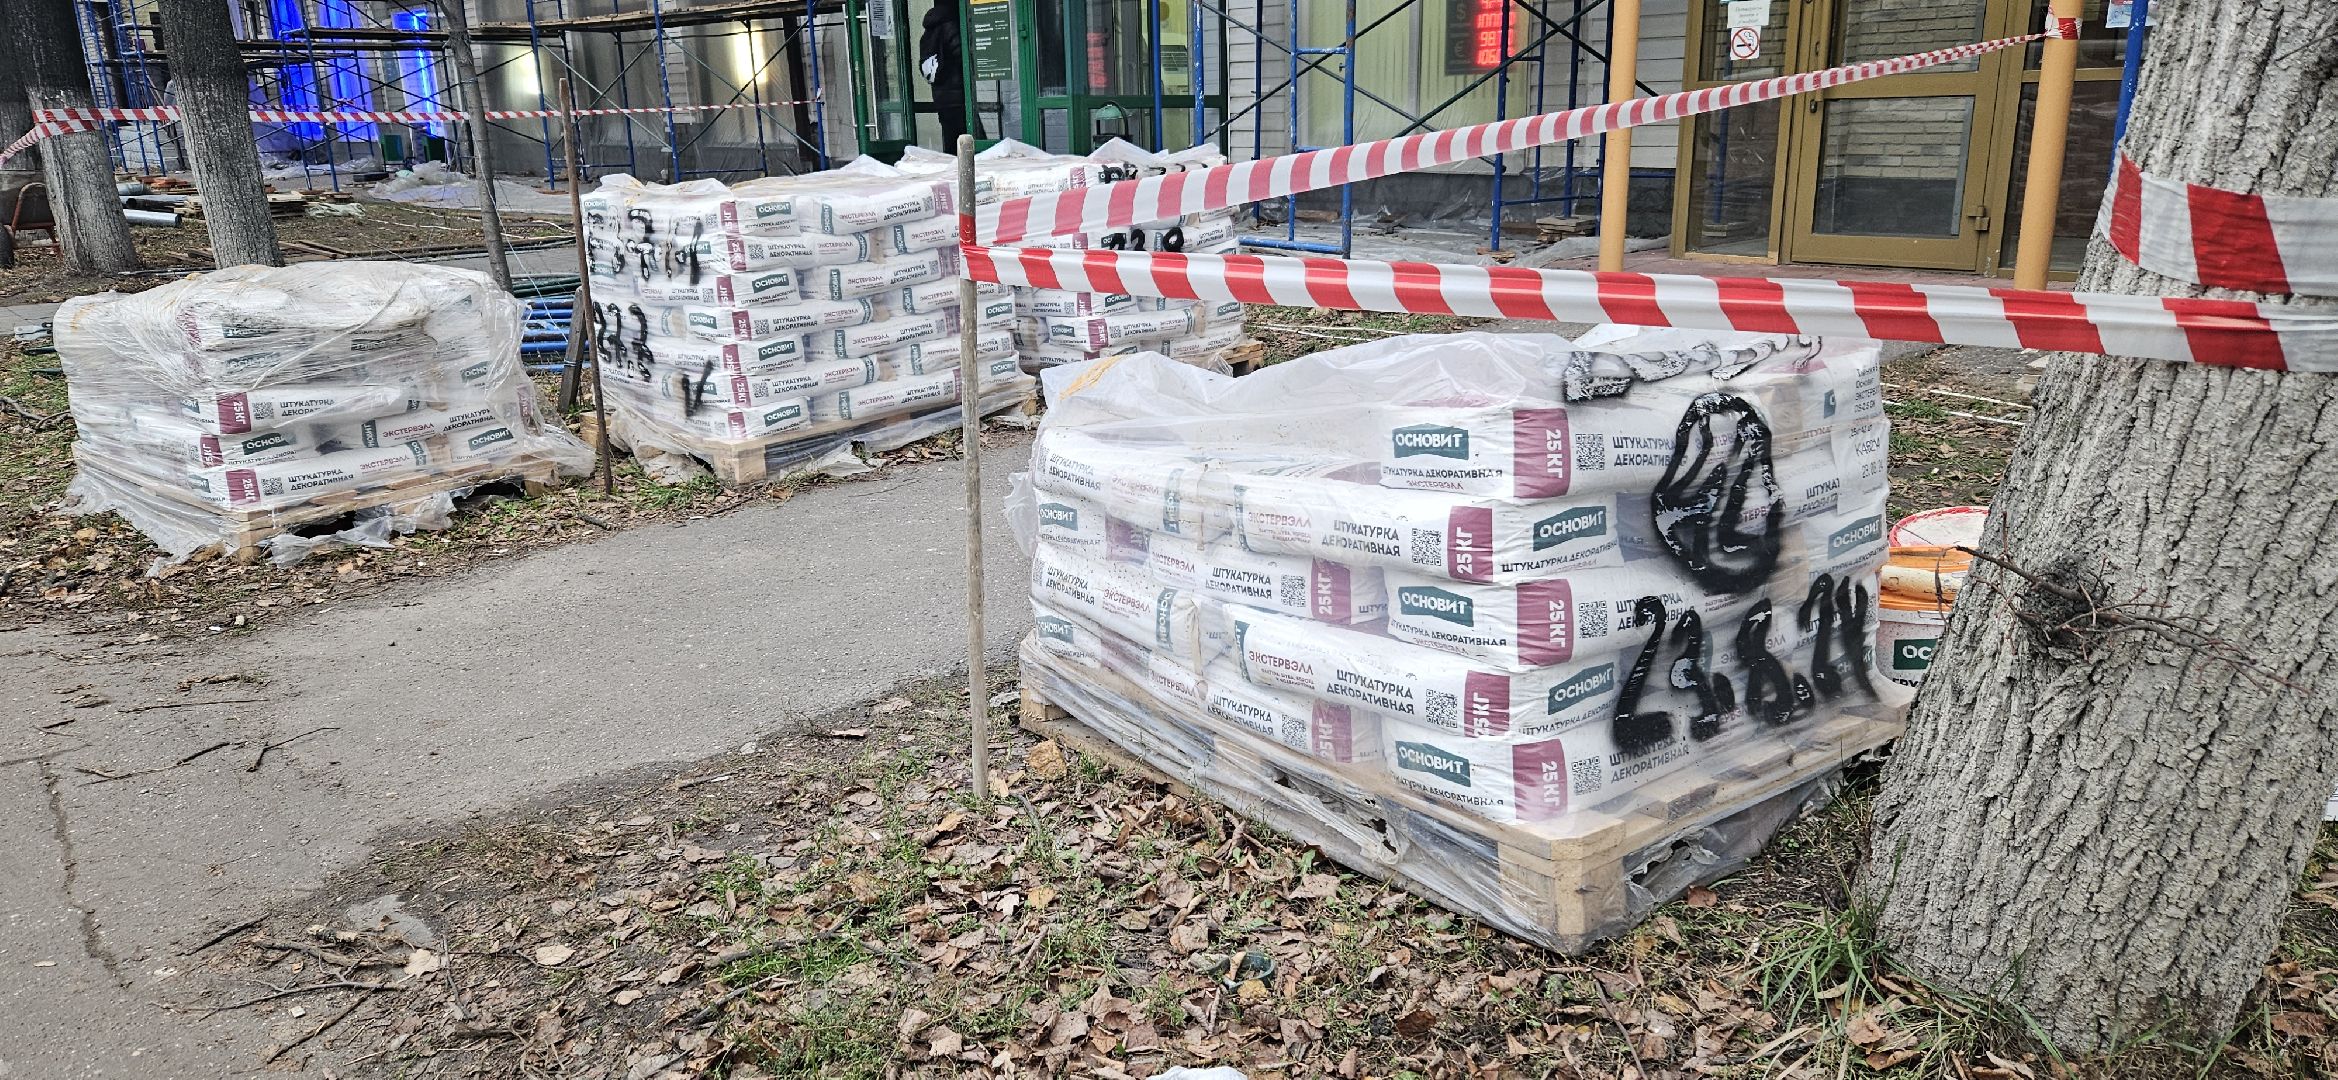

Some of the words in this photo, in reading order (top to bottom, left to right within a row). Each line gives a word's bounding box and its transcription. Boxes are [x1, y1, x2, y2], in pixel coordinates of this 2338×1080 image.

[754, 275, 788, 289] ОСНОВИТ
[760, 342, 795, 356] ОСНОВИТ
[233, 401, 246, 427] 25КГ
[280, 399, 335, 409] ШТУКАТУРКА
[767, 407, 800, 421] ОСНОВИТ
[382, 422, 435, 438] ЭКСТЕРВЭЛЛ
[471, 430, 510, 446] ОСНОВИТ
[1396, 433, 1463, 451] ОСНОВИТ
[1545, 428, 1563, 479] 25КГ
[288, 469, 343, 484] ШТУКАТУРКА
[291, 474, 354, 492] ДЕКОРАТИВНАЯ
[1425, 468, 1503, 482] ДЕКОРАТИВНАЯ
[1248, 511, 1312, 529] ЭКСТЕРВЭЛЛ
[1333, 519, 1400, 542] ШТУКАТУРКА
[1539, 510, 1604, 538] ОСНОВИТ
[1321, 534, 1401, 557] ДЕКОРАТИВНАЯ
[1833, 520, 1880, 548] ОСНОВИТ
[1456, 527, 1473, 577] 25КГ
[1212, 566, 1272, 586] ШТУКАТУРКА
[1045, 577, 1096, 606] ДЕКОРАТИВНАЯ
[1103, 588, 1151, 613] ЭКСТЕРВЭЛЛ
[1205, 579, 1273, 600] ДЕКОРАТИВНАЯ
[1401, 591, 1468, 615] ОСНОВИТ
[1548, 599, 1566, 648] 25КГ
[1431, 629, 1507, 647] ДЕКОРАТИВНАЯ
[1248, 650, 1315, 676] ЭКСТЕРВЭЛЛ
[1336, 668, 1414, 701] ШТУКАТУРКА
[1553, 667, 1614, 702] ОСНОВИТ
[1212, 694, 1273, 723] ШТУКАТУРКА
[1327, 683, 1416, 716] ДЕКОРАТИВНАЯ
[1398, 745, 1464, 776] ОСНОВИТ
[1610, 746, 1690, 784] ДЕКОРАТИВНАЯ
[1540, 759, 1559, 809] 25КГ
